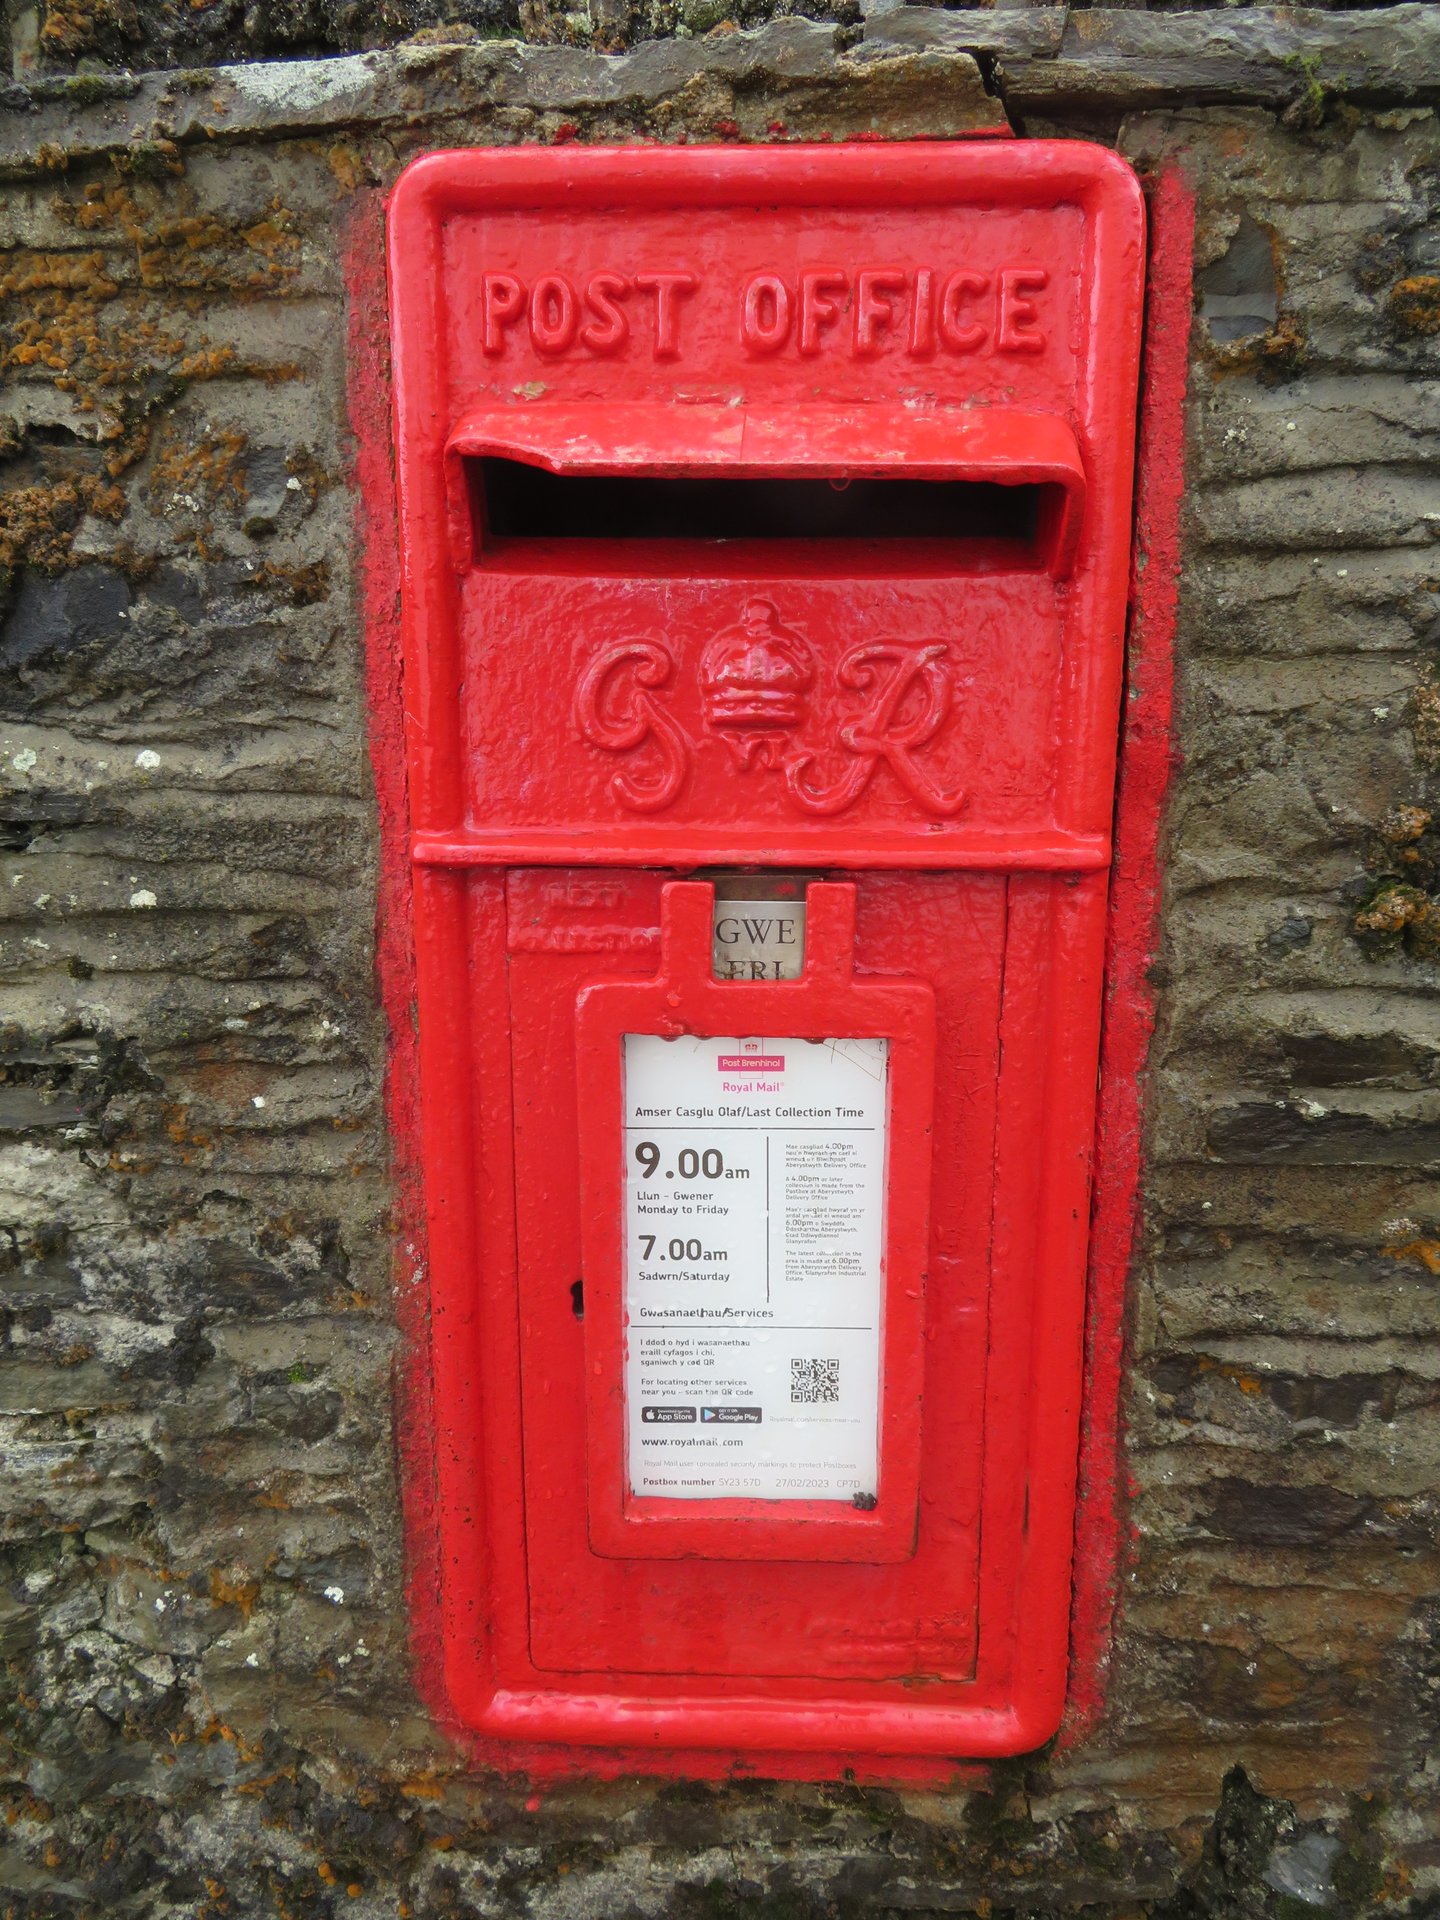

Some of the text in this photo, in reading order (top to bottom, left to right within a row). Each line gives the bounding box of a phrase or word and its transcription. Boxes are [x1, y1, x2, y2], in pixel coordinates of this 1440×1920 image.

[482, 268, 1048, 361] POST OFFICE
[576, 636, 687, 814] G
[786, 637, 967, 816] R
[716, 918, 795, 944] GWE
[723, 1059, 780, 1067] Post Brenhinol
[723, 1082, 752, 1094] Royal
[635, 1106, 864, 1119] Amser Casglu Olaf/Last Collection Time
[635, 1142, 749, 1179] 9.00am
[638, 1192, 660, 1200] Llun
[674, 1192, 713, 1200] Gwener
[638, 1205, 728, 1215] Monday to Friday
[638, 1235, 728, 1261] 7.00am
[639, 1271, 730, 1282] Sadwrn/Saturday
[640, 1308, 774, 1318] Gwasanaethau/Services
[676, 1339, 689, 1347] hyd
[641, 1359, 677, 1367] sganiwch
[657, 1379, 688, 1387] locating
[642, 1438, 743, 1448] www.royalmail.com
[643, 1478, 677, 1486] Postbox
[682, 1478, 715, 1486] number
[719, 1478, 740, 1486] SY23
[776, 1479, 829, 1488] 27/02/2023
